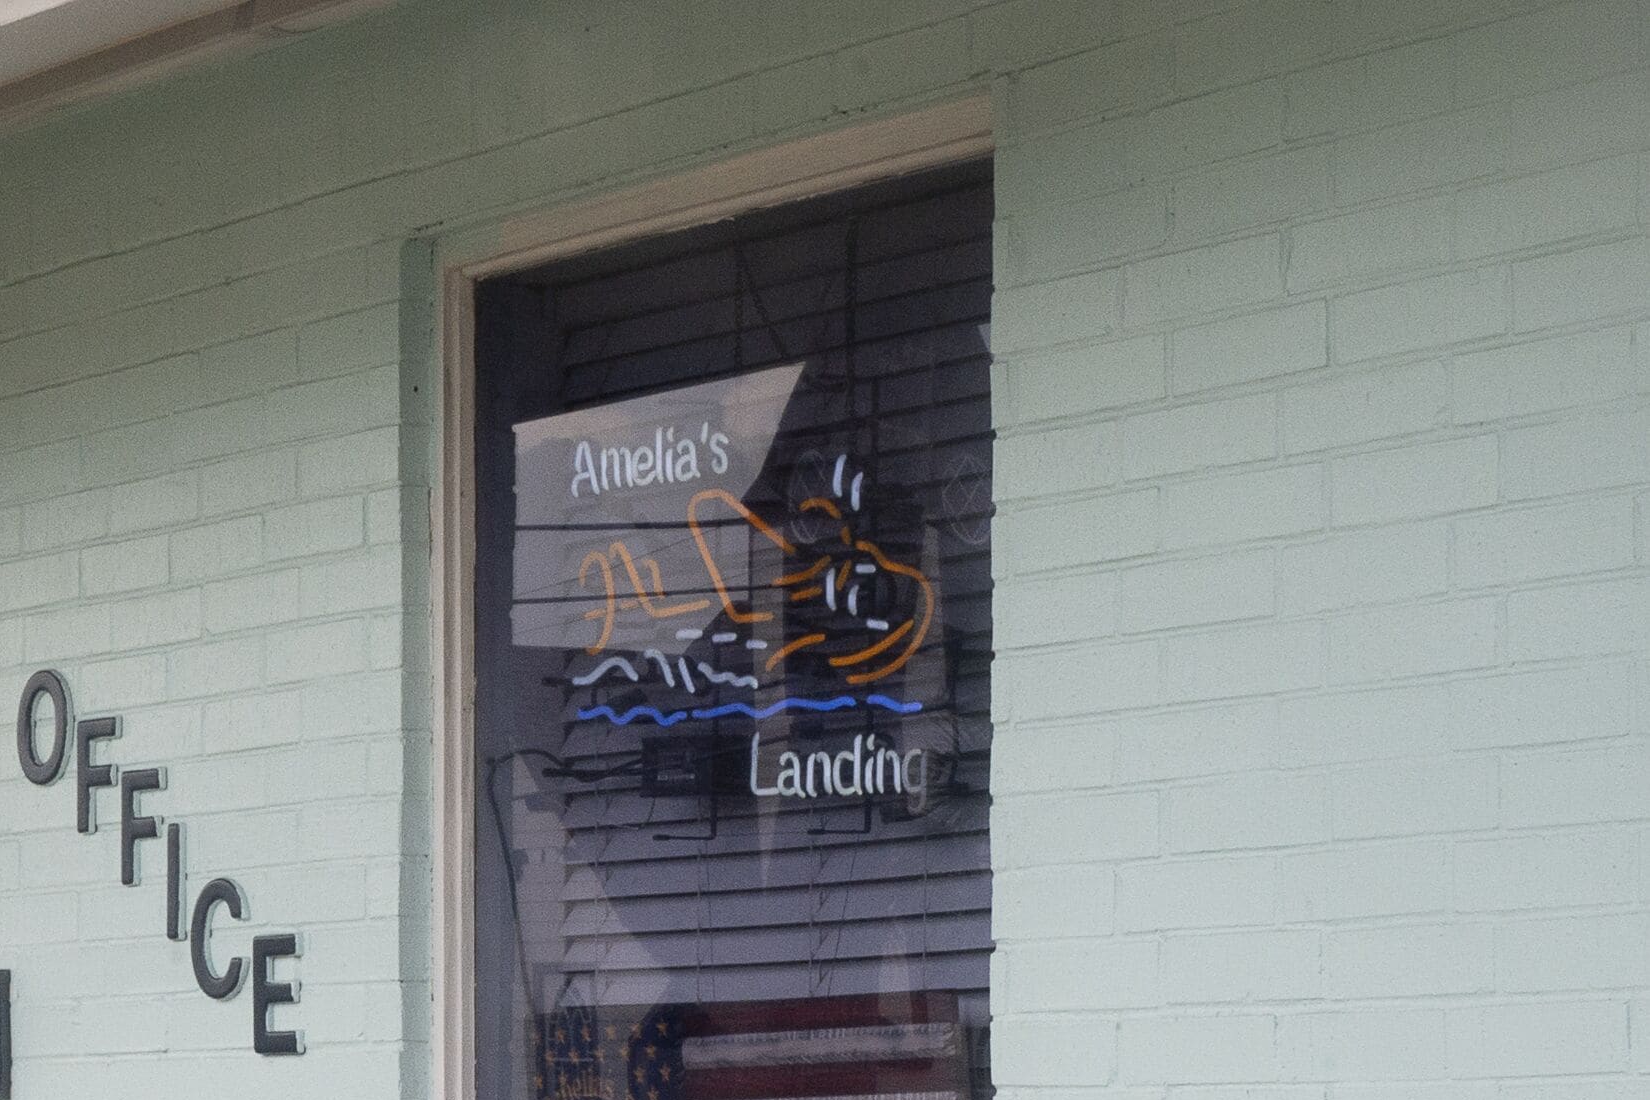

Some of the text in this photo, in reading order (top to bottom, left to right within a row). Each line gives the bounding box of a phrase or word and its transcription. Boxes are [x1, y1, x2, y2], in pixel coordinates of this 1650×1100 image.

[571, 422, 729, 498] Amelia's
[751, 732, 930, 815] Landing
[16, 668, 306, 1056] OFFICE
